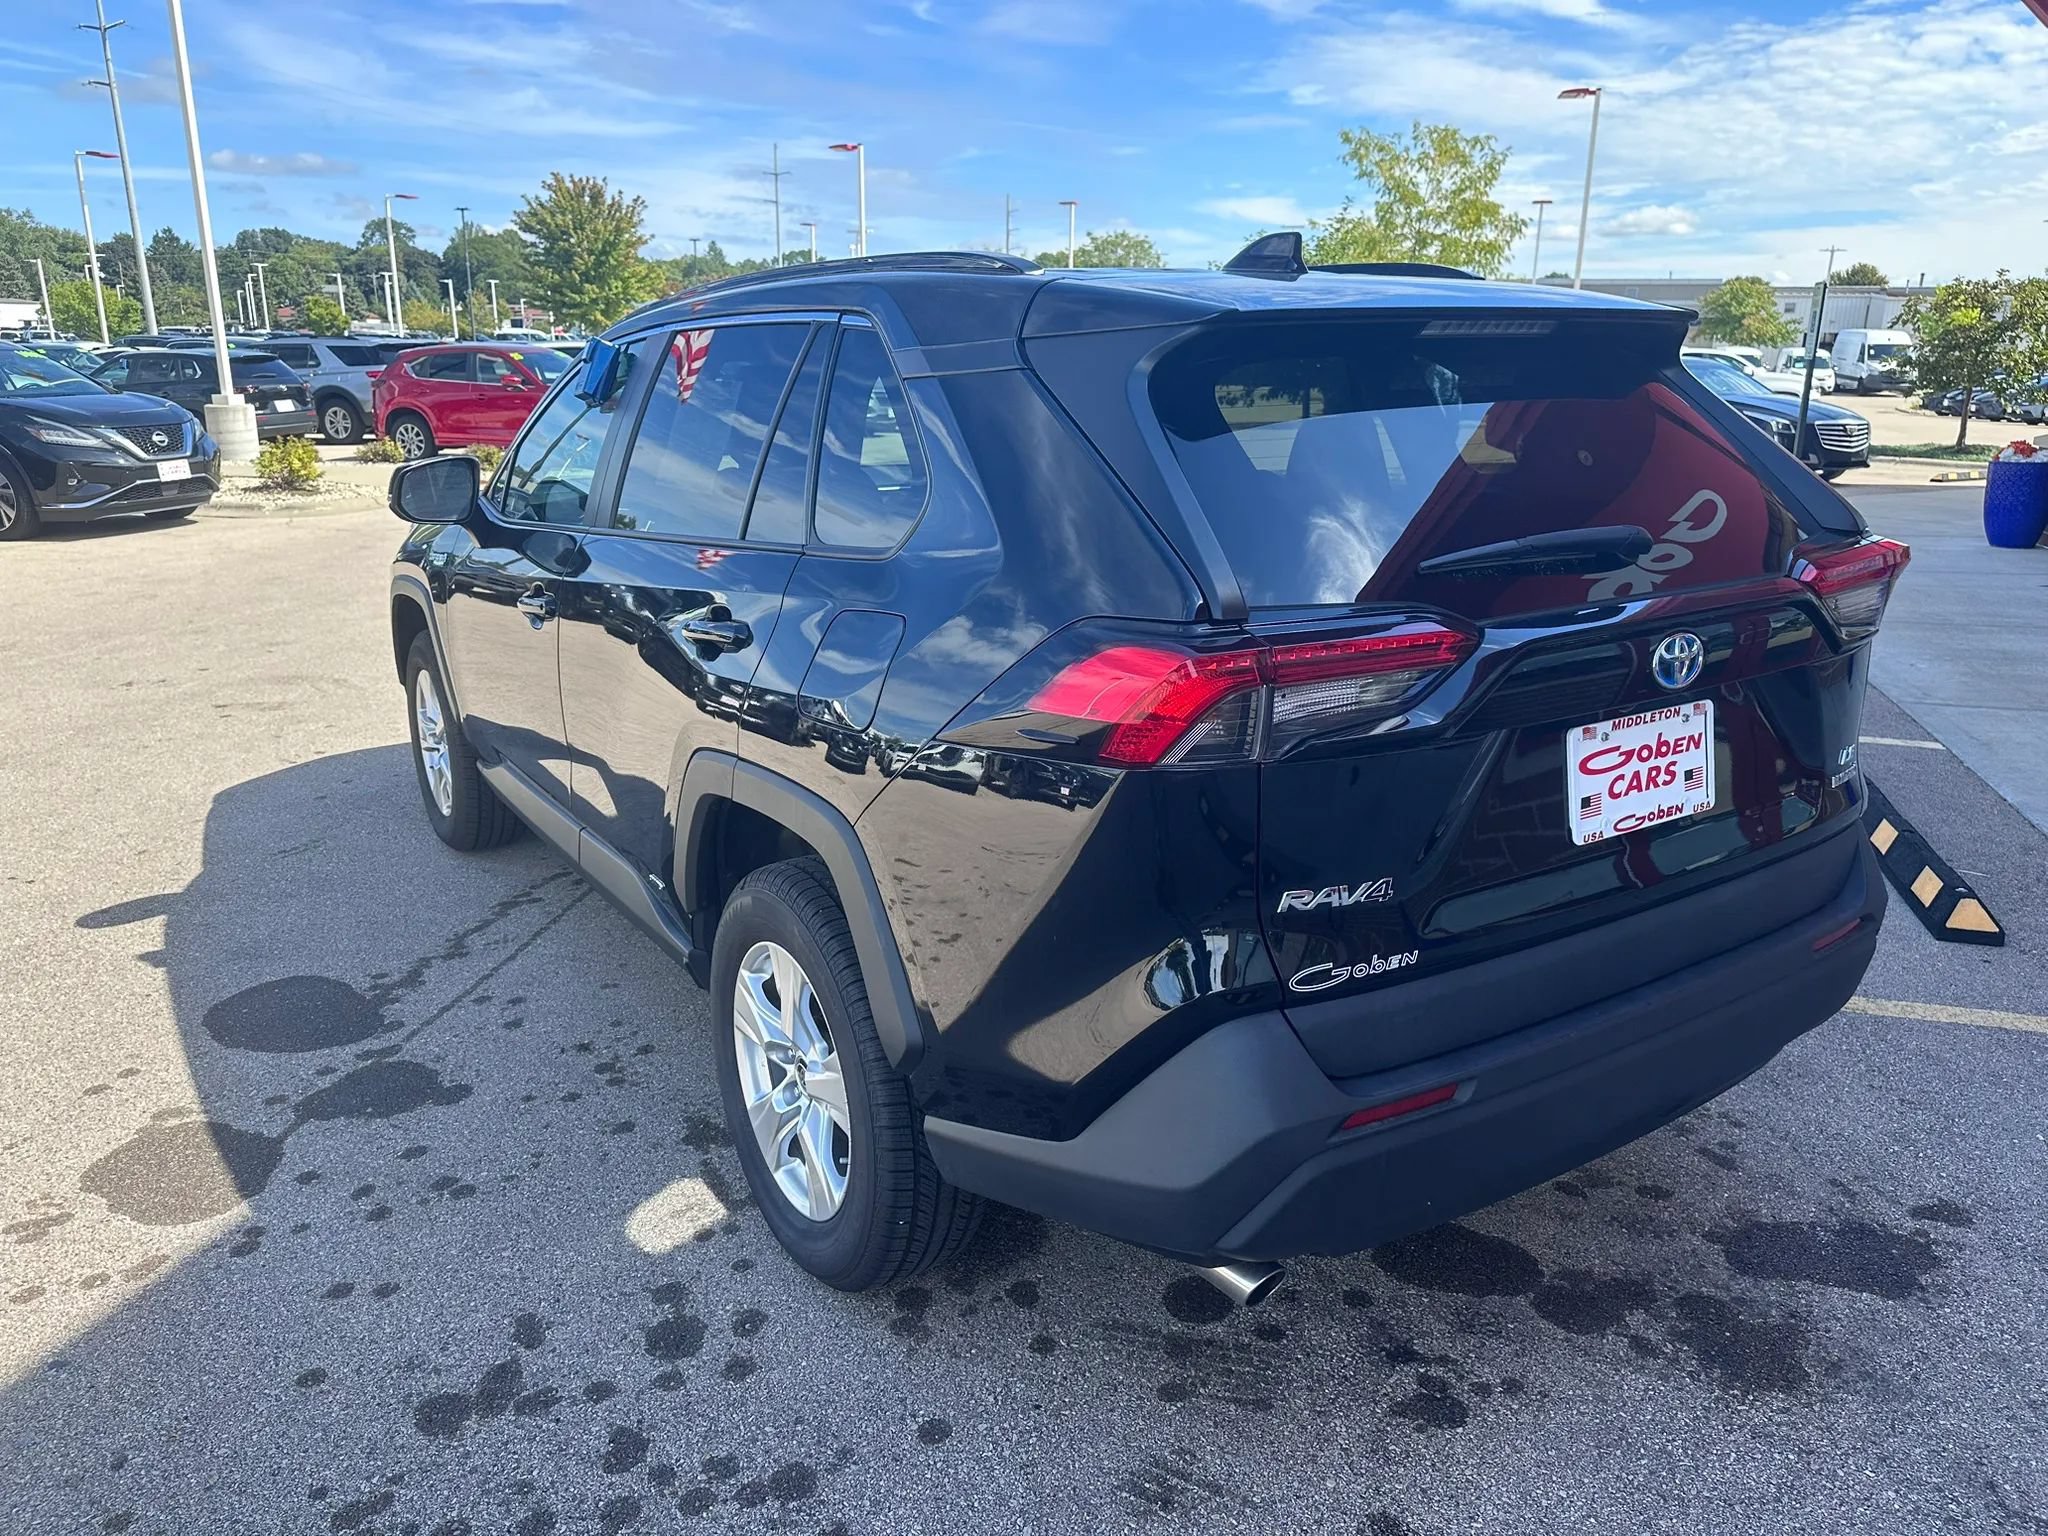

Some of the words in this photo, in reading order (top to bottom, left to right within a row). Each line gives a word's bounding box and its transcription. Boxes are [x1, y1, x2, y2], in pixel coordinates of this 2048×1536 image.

[1611, 707, 1681, 731] MIDDLETON
[1607, 761, 1678, 800] CARS
[1692, 801, 1711, 813] USA
[1583, 831, 1604, 843] USA
[1277, 877, 1393, 913] RAV4
